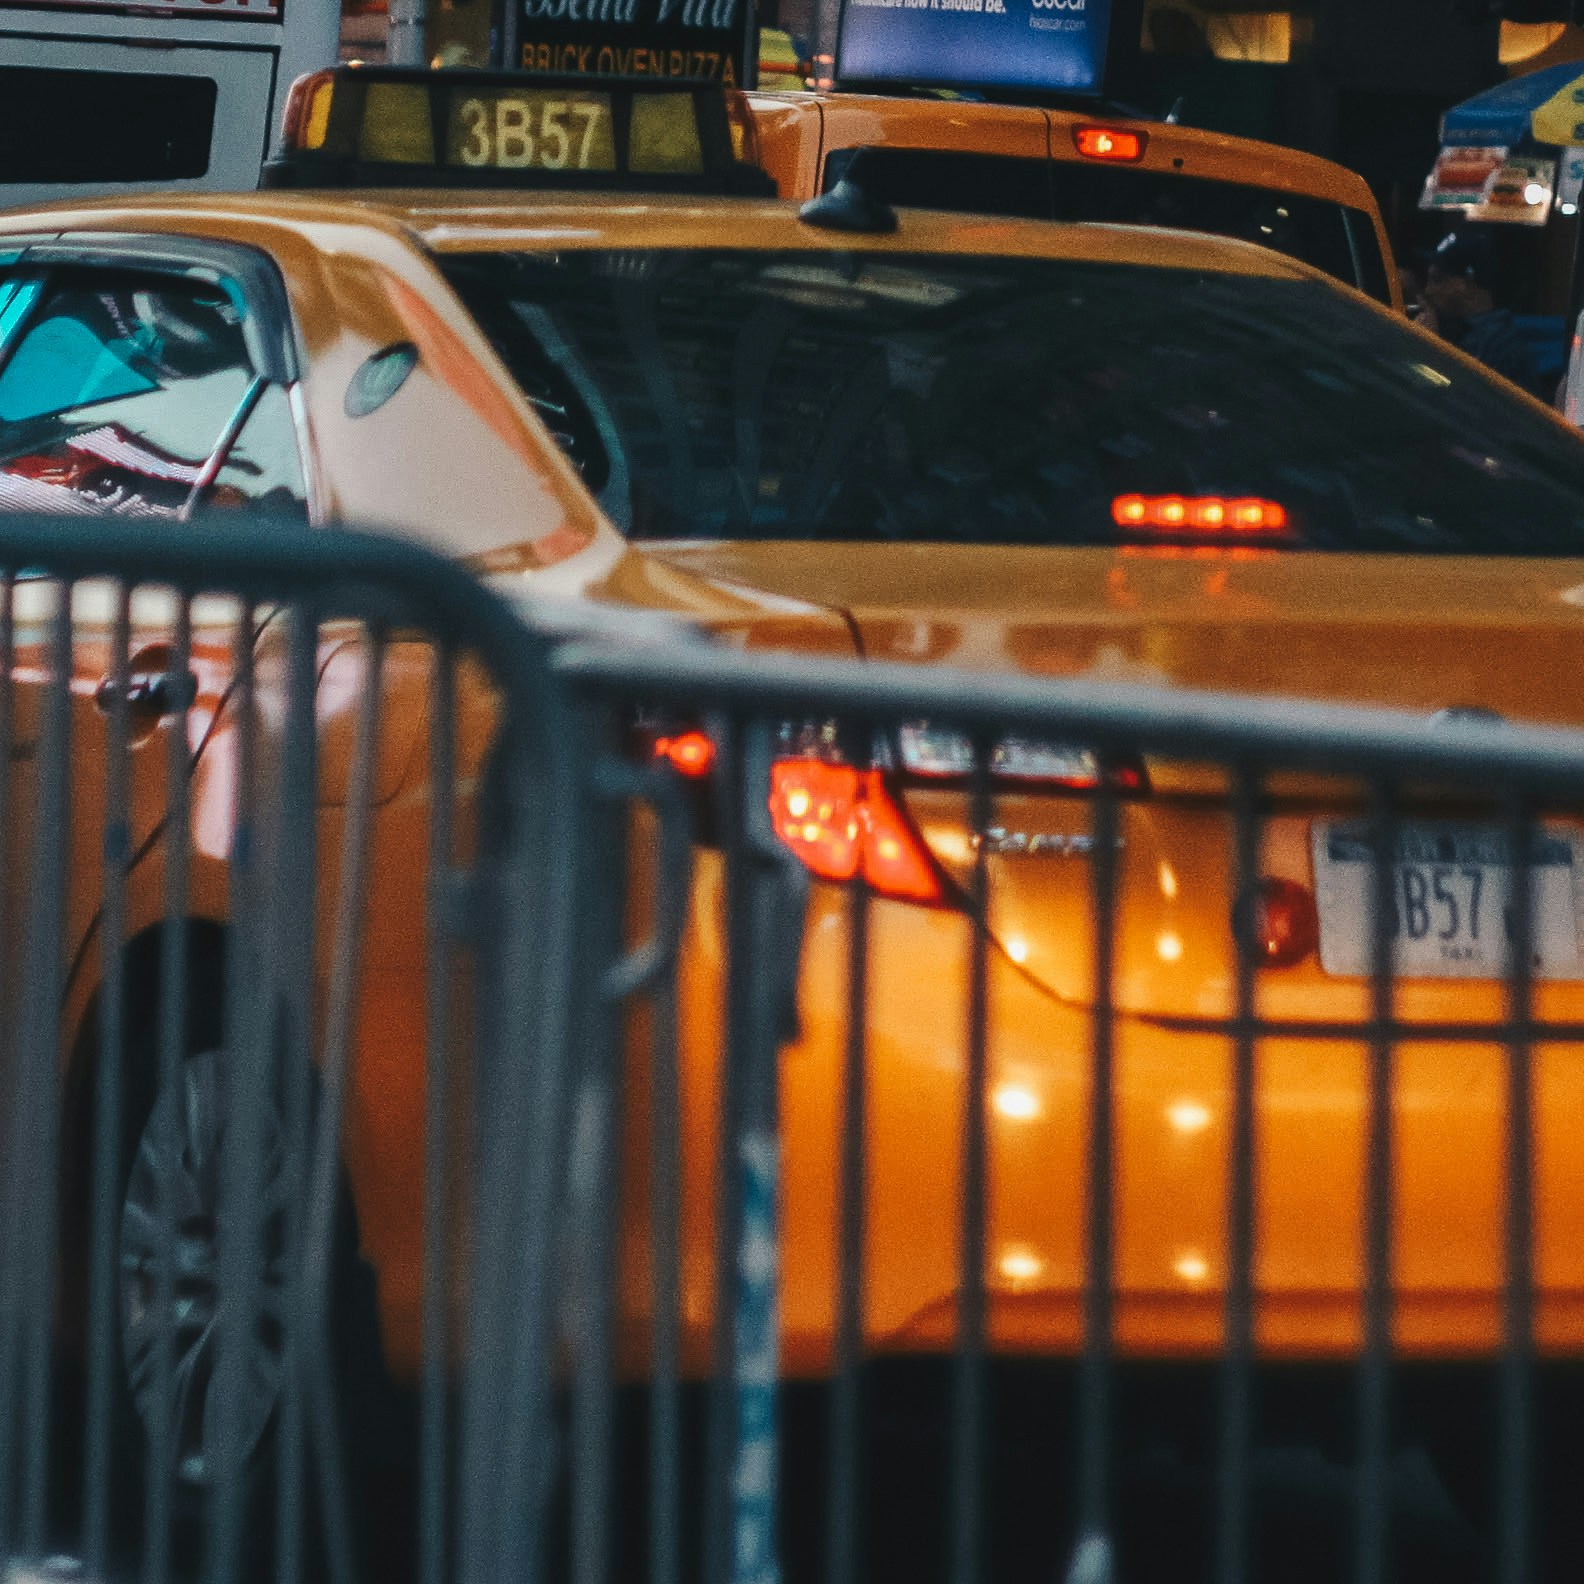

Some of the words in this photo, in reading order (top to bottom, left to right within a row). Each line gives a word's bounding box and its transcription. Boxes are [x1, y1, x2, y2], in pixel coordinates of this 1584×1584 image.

[521, 43, 592, 74] BRICK
[597, 46, 664, 78] OVEN
[669, 49, 736, 88] PIZZA
[459, 98, 607, 170] 3B57
